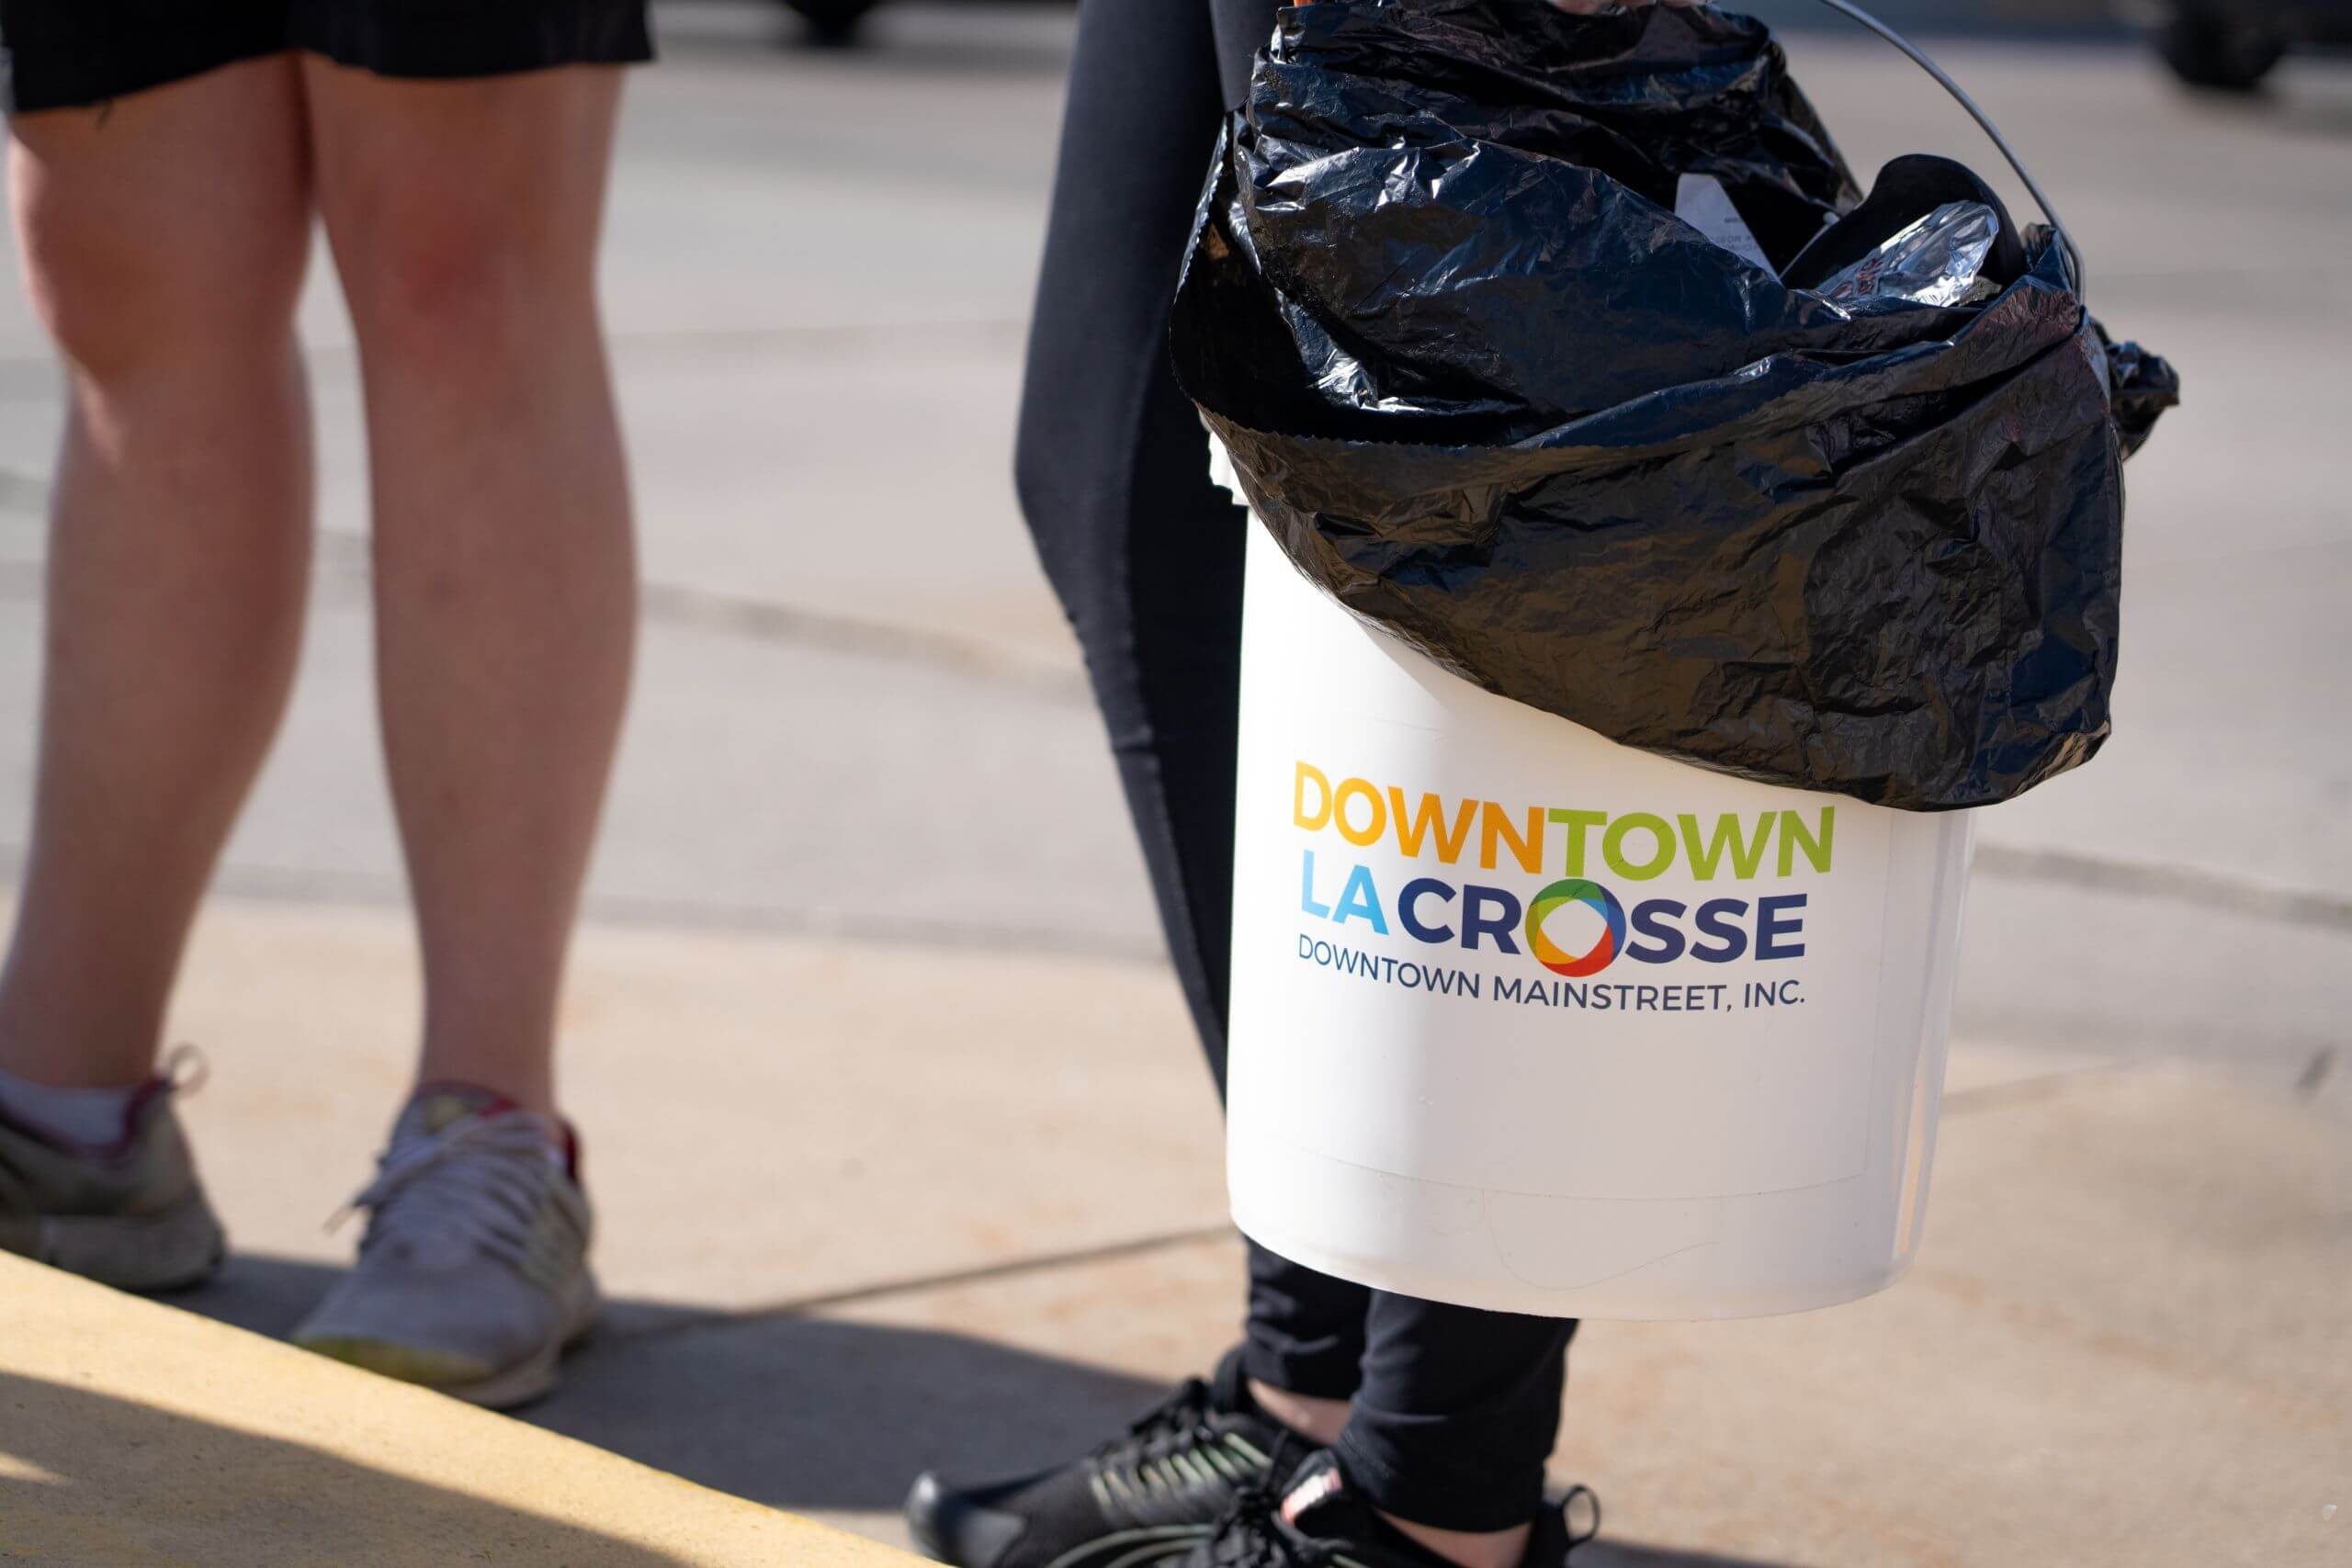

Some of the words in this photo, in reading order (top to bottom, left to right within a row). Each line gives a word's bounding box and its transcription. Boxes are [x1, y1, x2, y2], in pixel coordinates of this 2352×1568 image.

[1293, 761, 1835, 882] DOWNTOWN
[1298, 933, 1480, 998] DOWNTOWN
[1493, 976, 1733, 1012] MAINSTREET,
[1744, 979, 1805, 1008] INC.
[1301, 849, 1389, 936] LA
[1397, 877, 1807, 977] CROSSE
